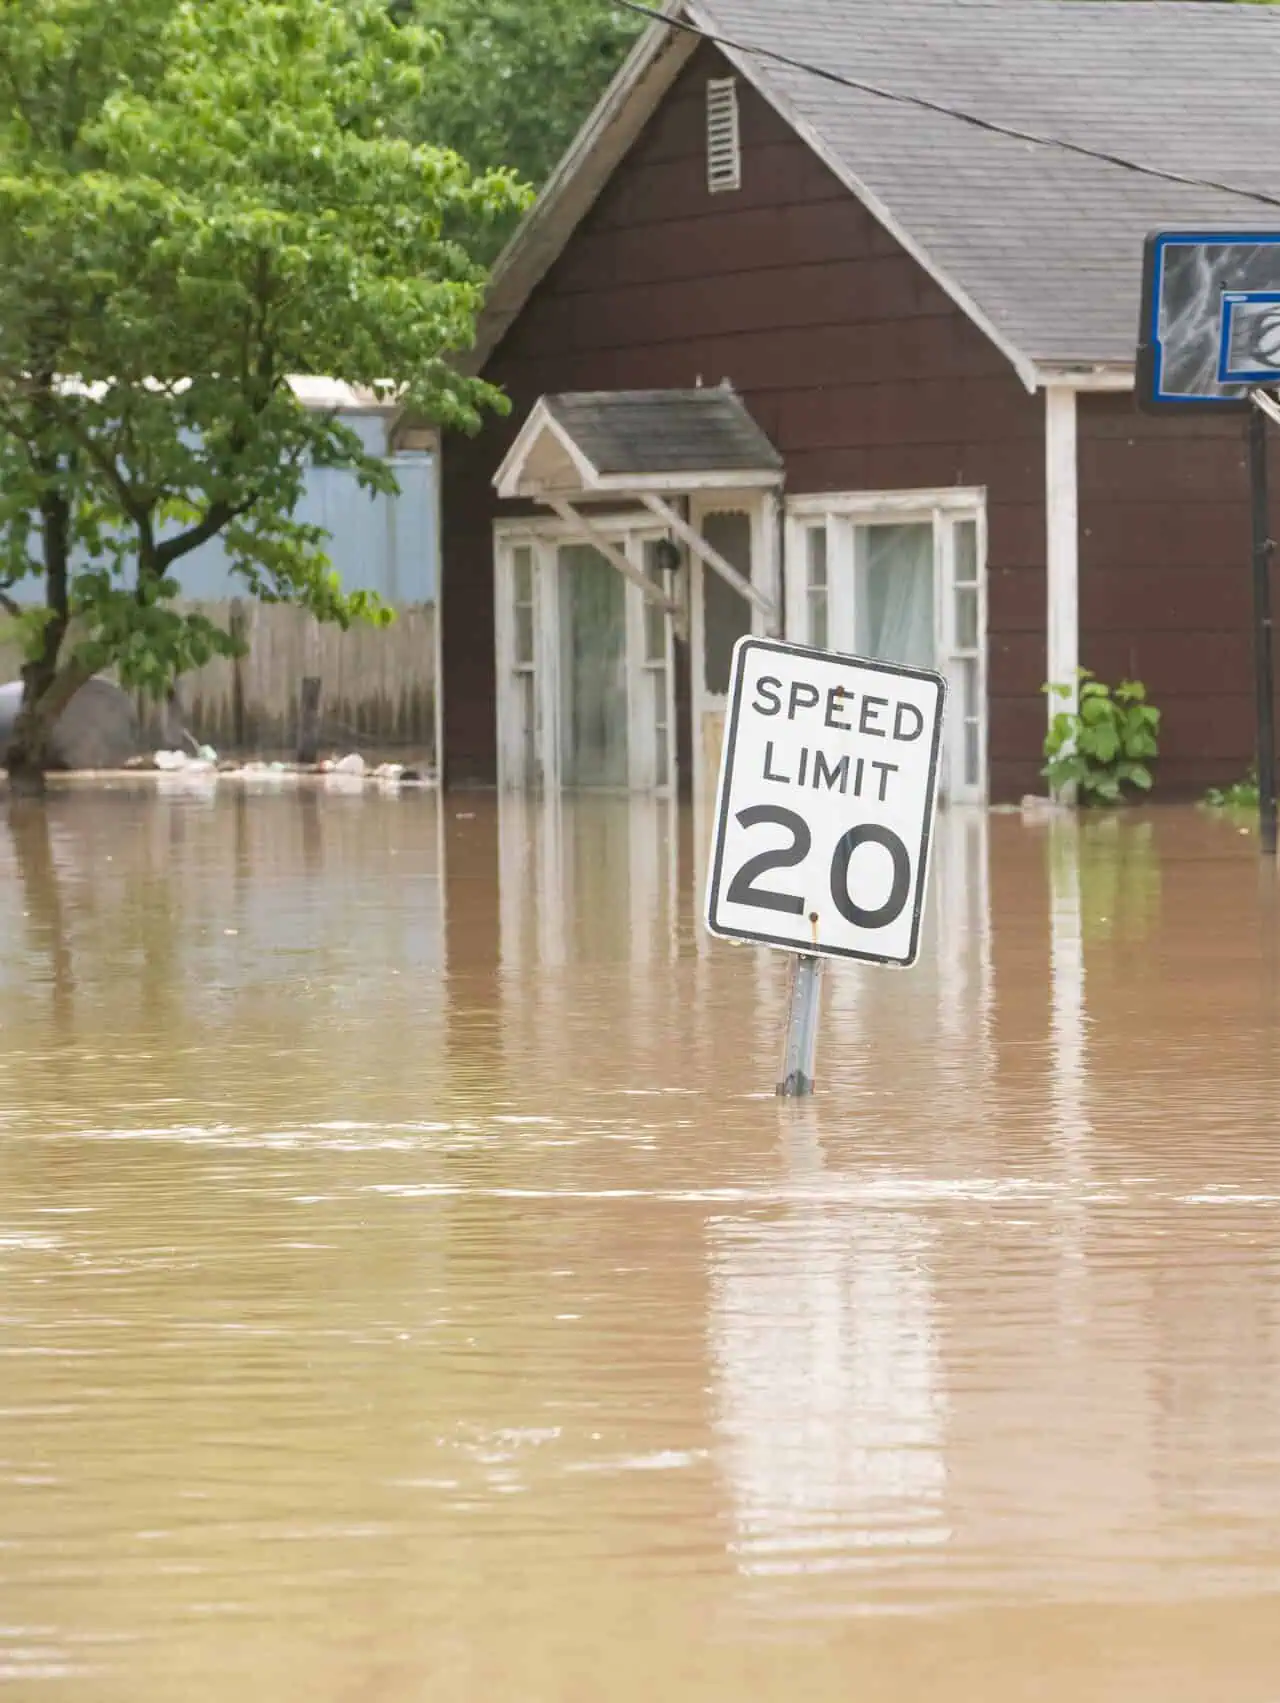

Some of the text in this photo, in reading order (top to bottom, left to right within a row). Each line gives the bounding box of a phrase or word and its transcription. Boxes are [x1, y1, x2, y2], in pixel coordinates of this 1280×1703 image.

[752, 675, 924, 742] SPEED
[762, 740, 899, 801] LIMIT
[726, 804, 911, 929] 20
